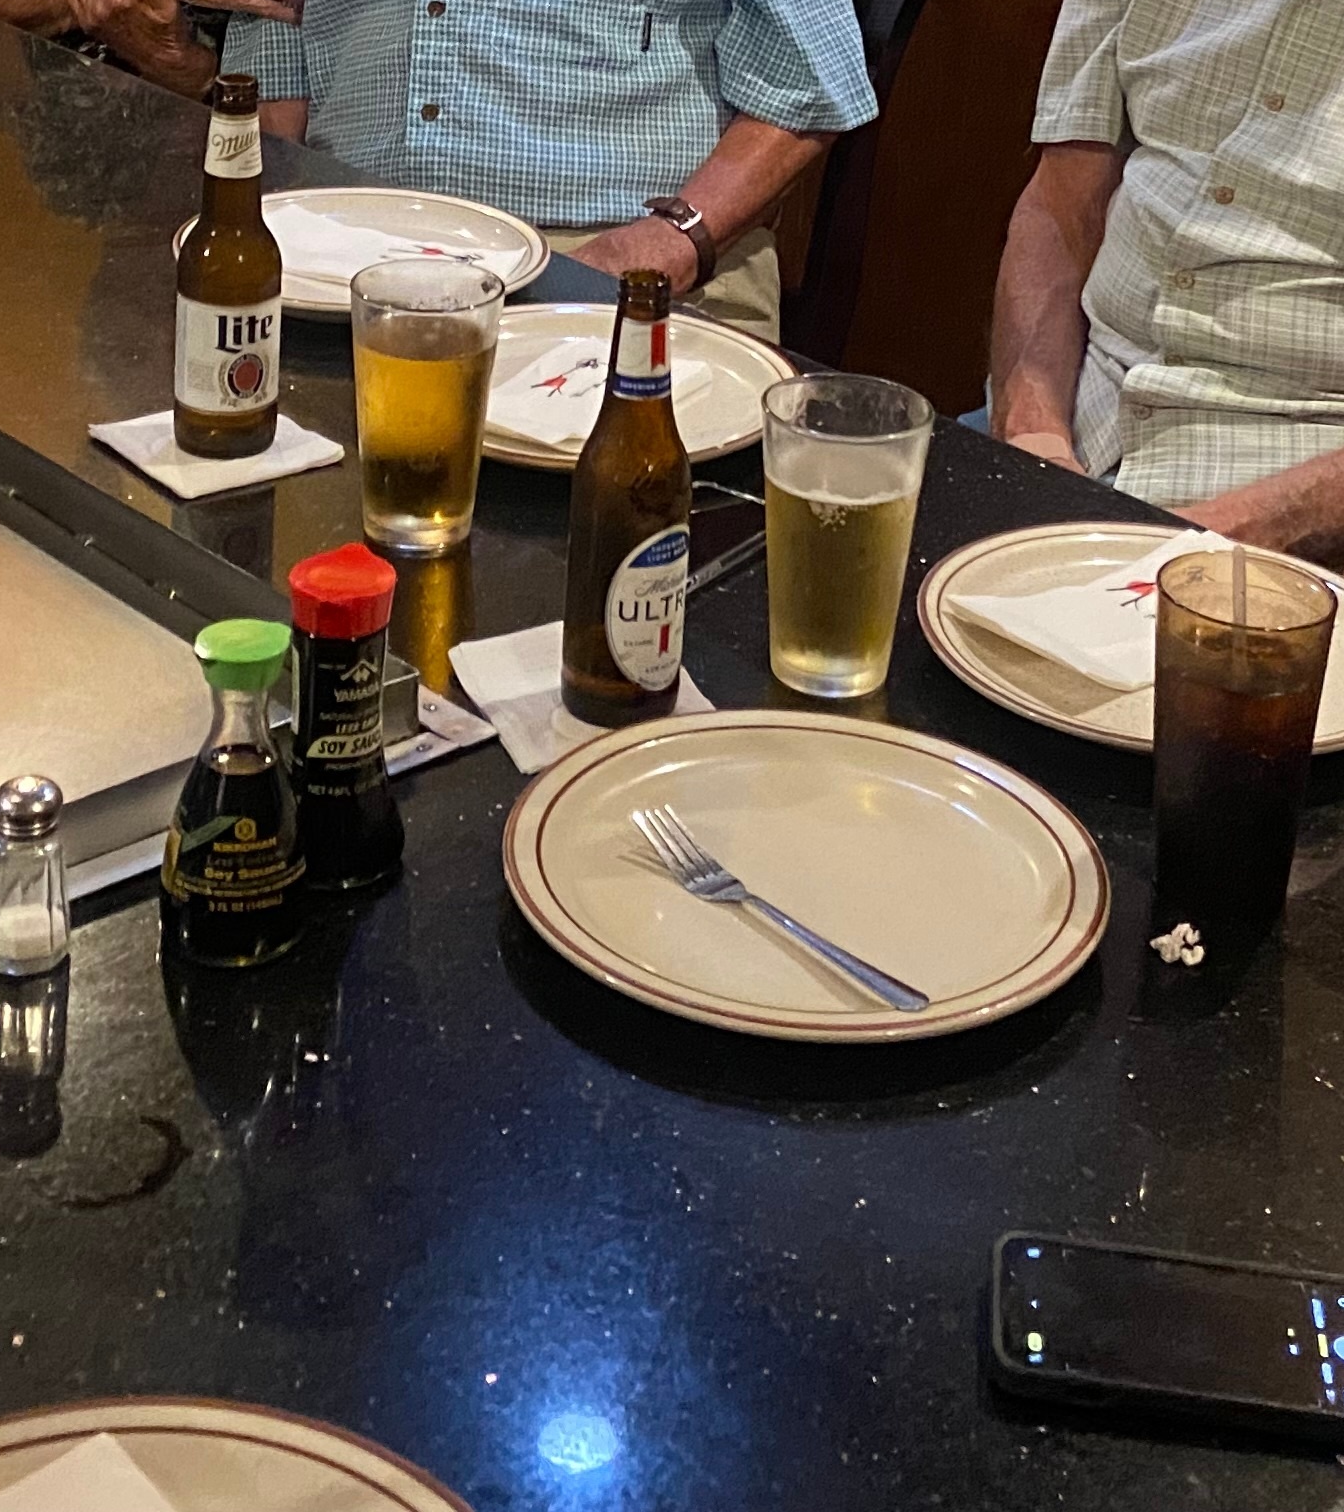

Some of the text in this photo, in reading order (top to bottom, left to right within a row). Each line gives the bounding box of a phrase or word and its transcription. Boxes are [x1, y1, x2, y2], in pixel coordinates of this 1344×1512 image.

[215, 314, 273, 354] Lite
[619, 588, 685, 622] ULTR
[318, 729, 382, 755] SOY SAUC
